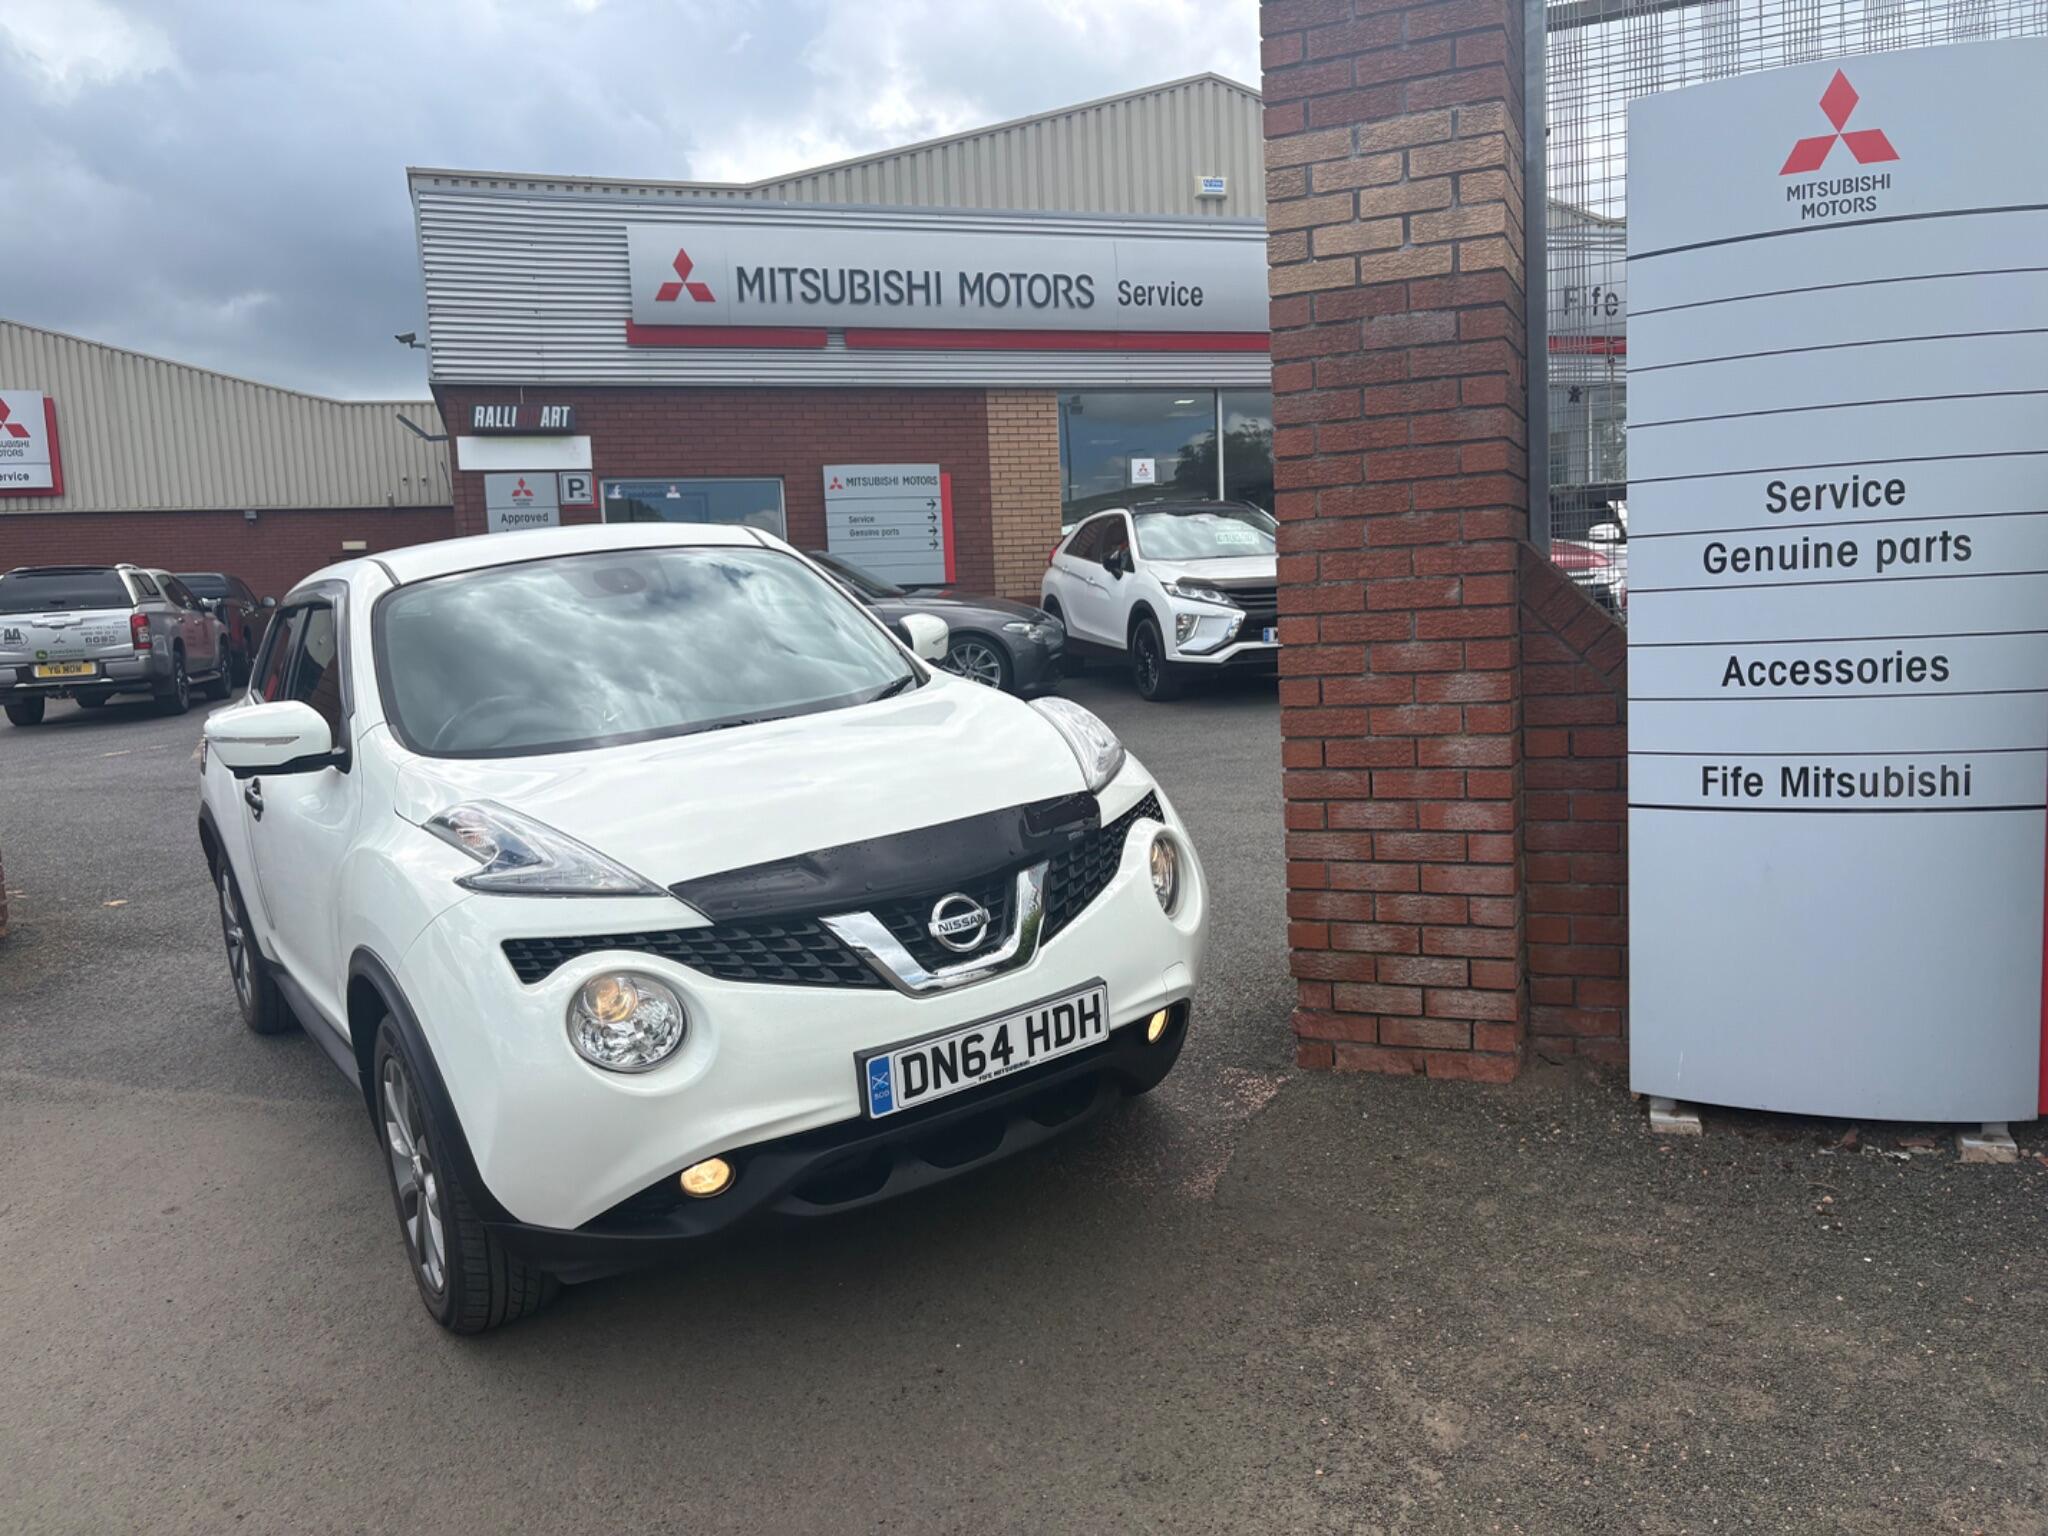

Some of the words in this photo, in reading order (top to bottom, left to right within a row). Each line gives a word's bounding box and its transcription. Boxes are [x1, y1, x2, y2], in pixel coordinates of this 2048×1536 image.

[1786, 173, 1891, 202] MITSUBISHI
[1801, 195, 1877, 220] MOTORS
[736, 266, 942, 306] MITSUBISHI
[958, 271, 1095, 309] MOTORS
[1117, 279, 1204, 308] Service
[1564, 286, 1618, 316] Fife
[474, 406, 518, 428] RALLI
[540, 406, 571, 428] ART
[845, 476, 899, 487] MITSUBISHI
[902, 475, 939, 486] MOTORS
[1765, 474, 1906, 514] Service
[501, 512, 549, 525] Approved
[848, 515, 875, 524] Service
[849, 528, 880, 538] Genuine
[881, 528, 900, 538] parts
[1703, 536, 1858, 575] Genuine
[1876, 530, 1973, 574] parts
[1721, 650, 1950, 687] Accessories
[1702, 765, 1764, 798] Fife
[1780, 763, 1971, 798] Mitsubishi
[938, 914, 986, 933] NISSAN
[901, 1023, 1014, 1099] DN64
[1026, 993, 1101, 1058] HDH
